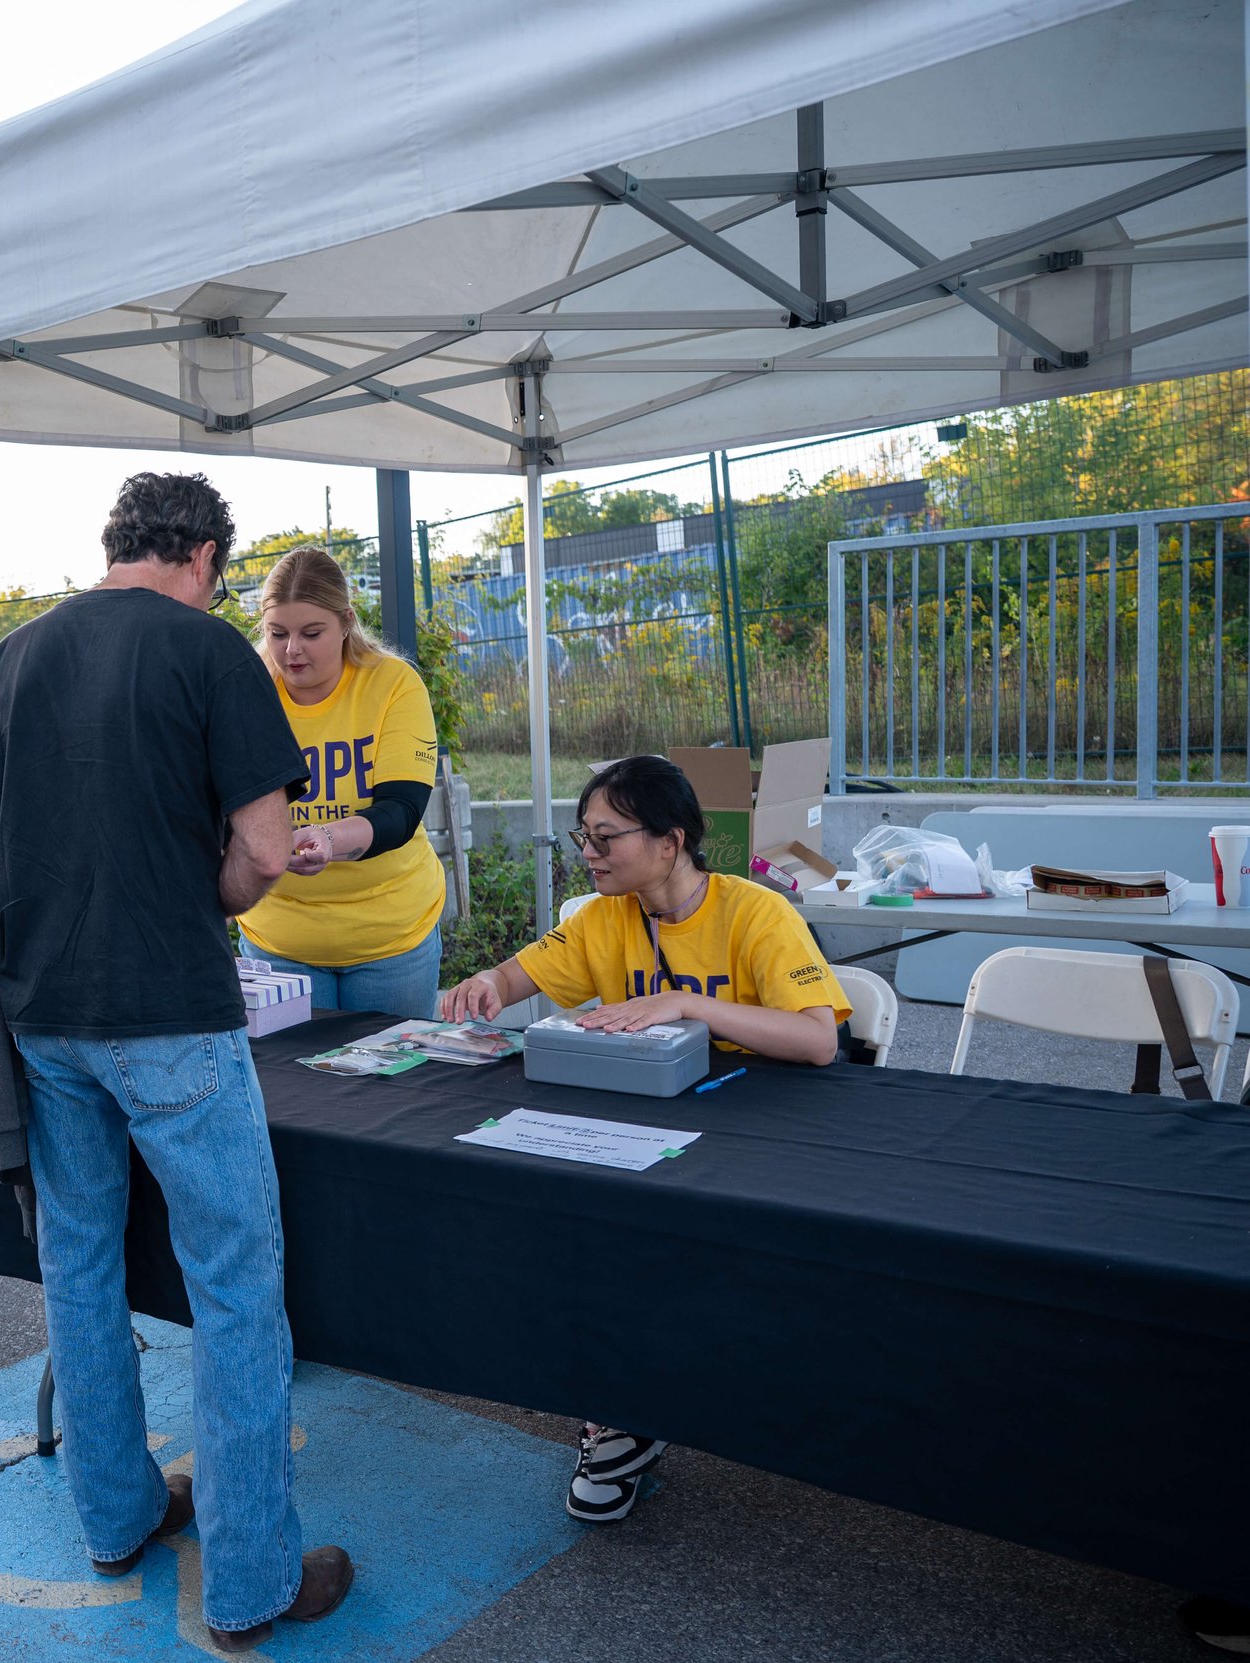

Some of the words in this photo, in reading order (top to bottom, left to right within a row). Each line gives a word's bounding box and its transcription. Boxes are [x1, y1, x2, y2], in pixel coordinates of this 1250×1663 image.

[314, 805, 350, 820] THE
[789, 965, 818, 979] GREEN
[518, 1118, 549, 1127] Ticket
[611, 1133, 651, 1141] person
[534, 1136, 591, 1147] appreciate
